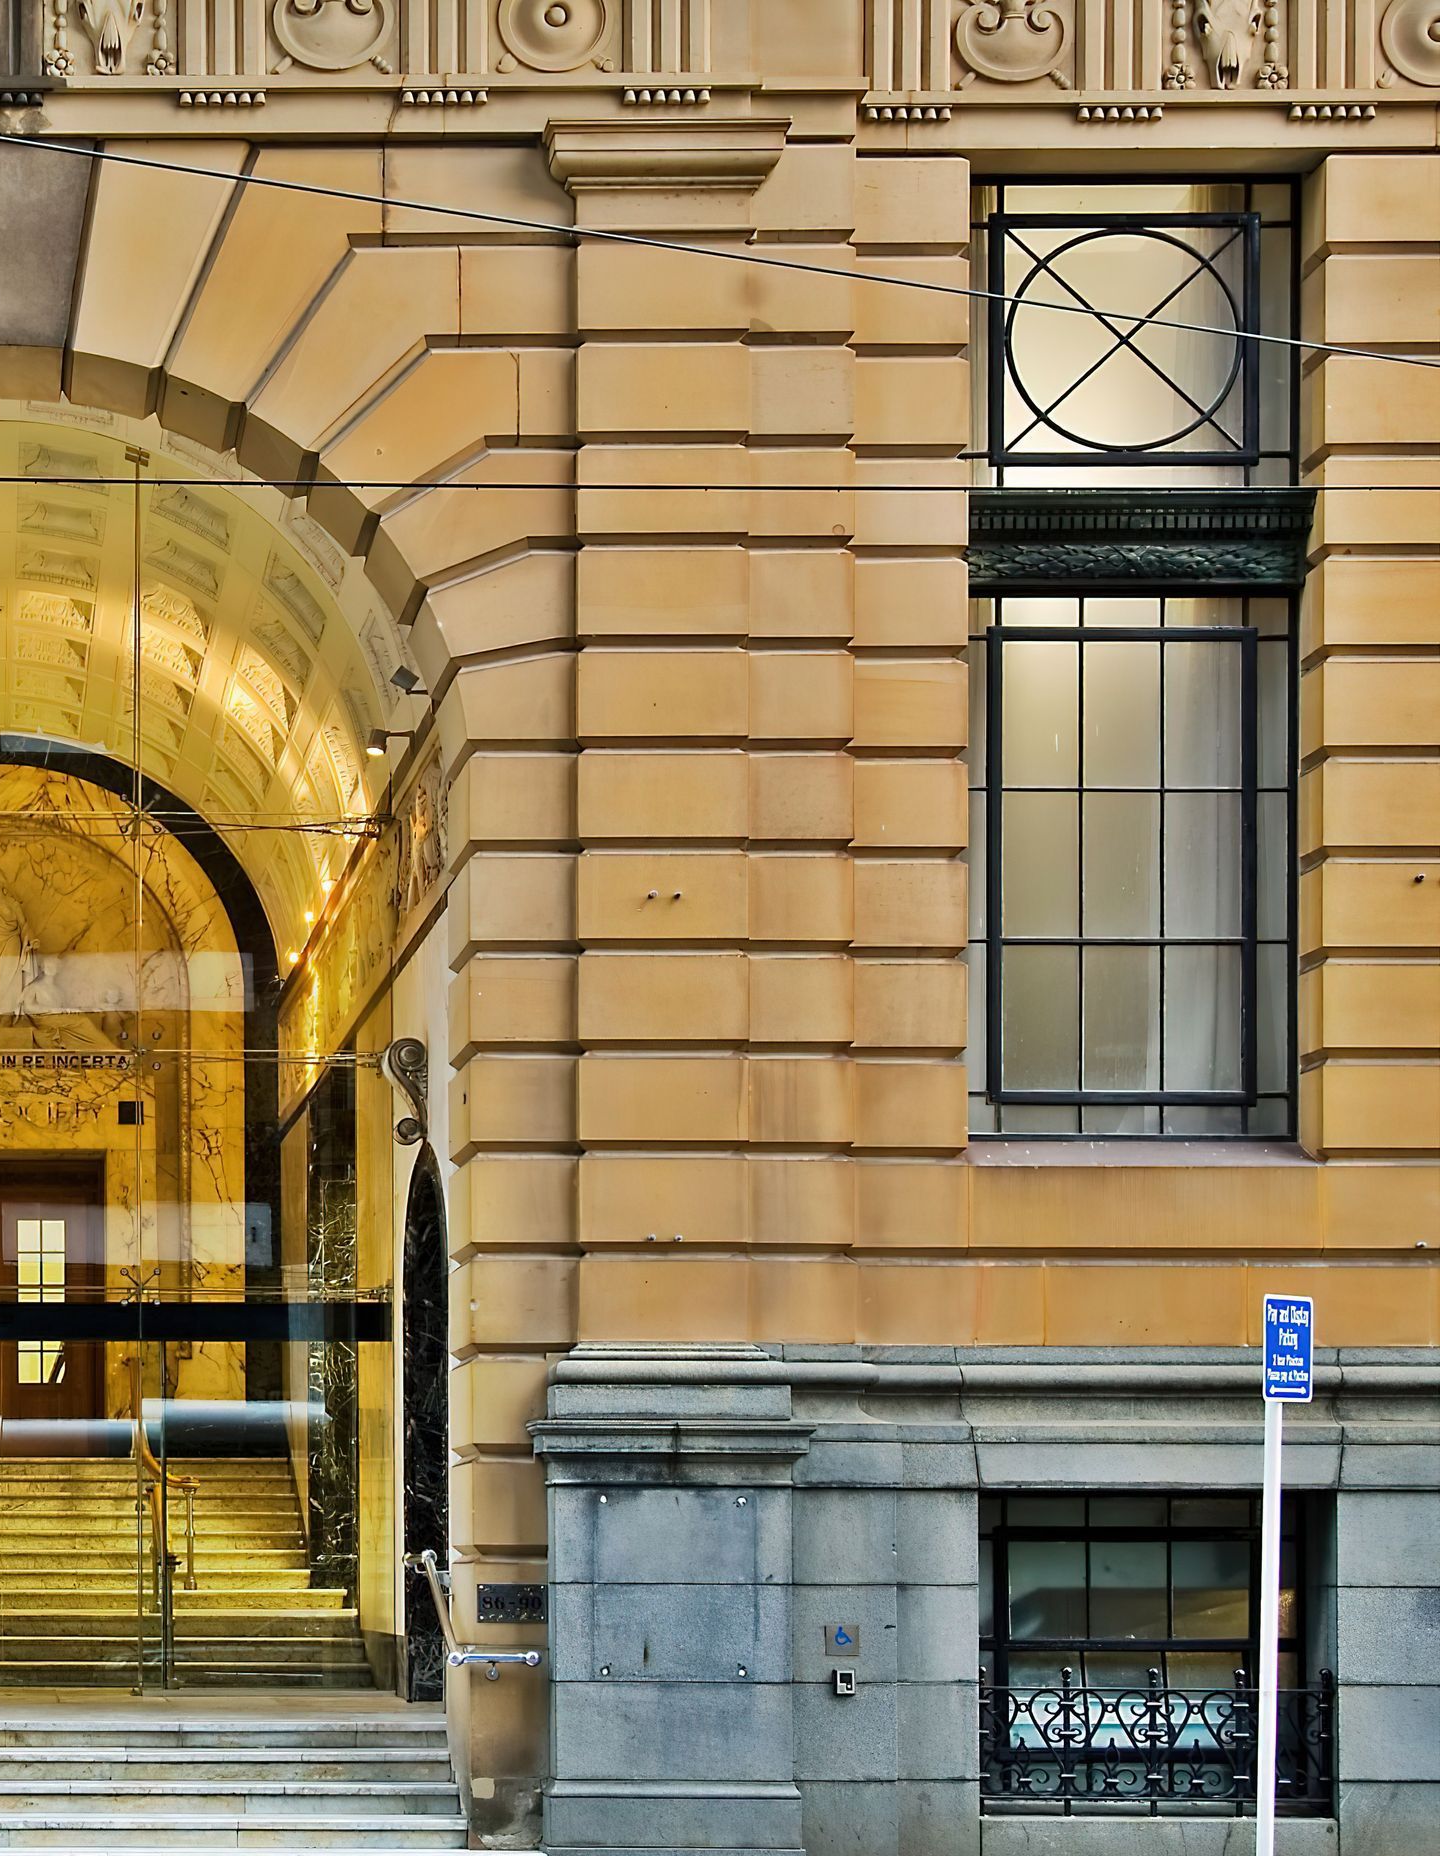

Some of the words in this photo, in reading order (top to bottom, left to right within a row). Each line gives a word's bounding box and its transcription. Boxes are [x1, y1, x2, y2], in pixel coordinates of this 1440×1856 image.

[2, 1055, 16, 1068] IN
[23, 1055, 45, 1068] RE
[52, 1055, 128, 1069] INCERTA
[1267, 1304, 1278, 1326] Pay
[1279, 1305, 1290, 1323] and
[1290, 1305, 1309, 1328] Display
[1278, 1327, 1299, 1350] Parking
[481, 1596, 543, 1611] 86-90
